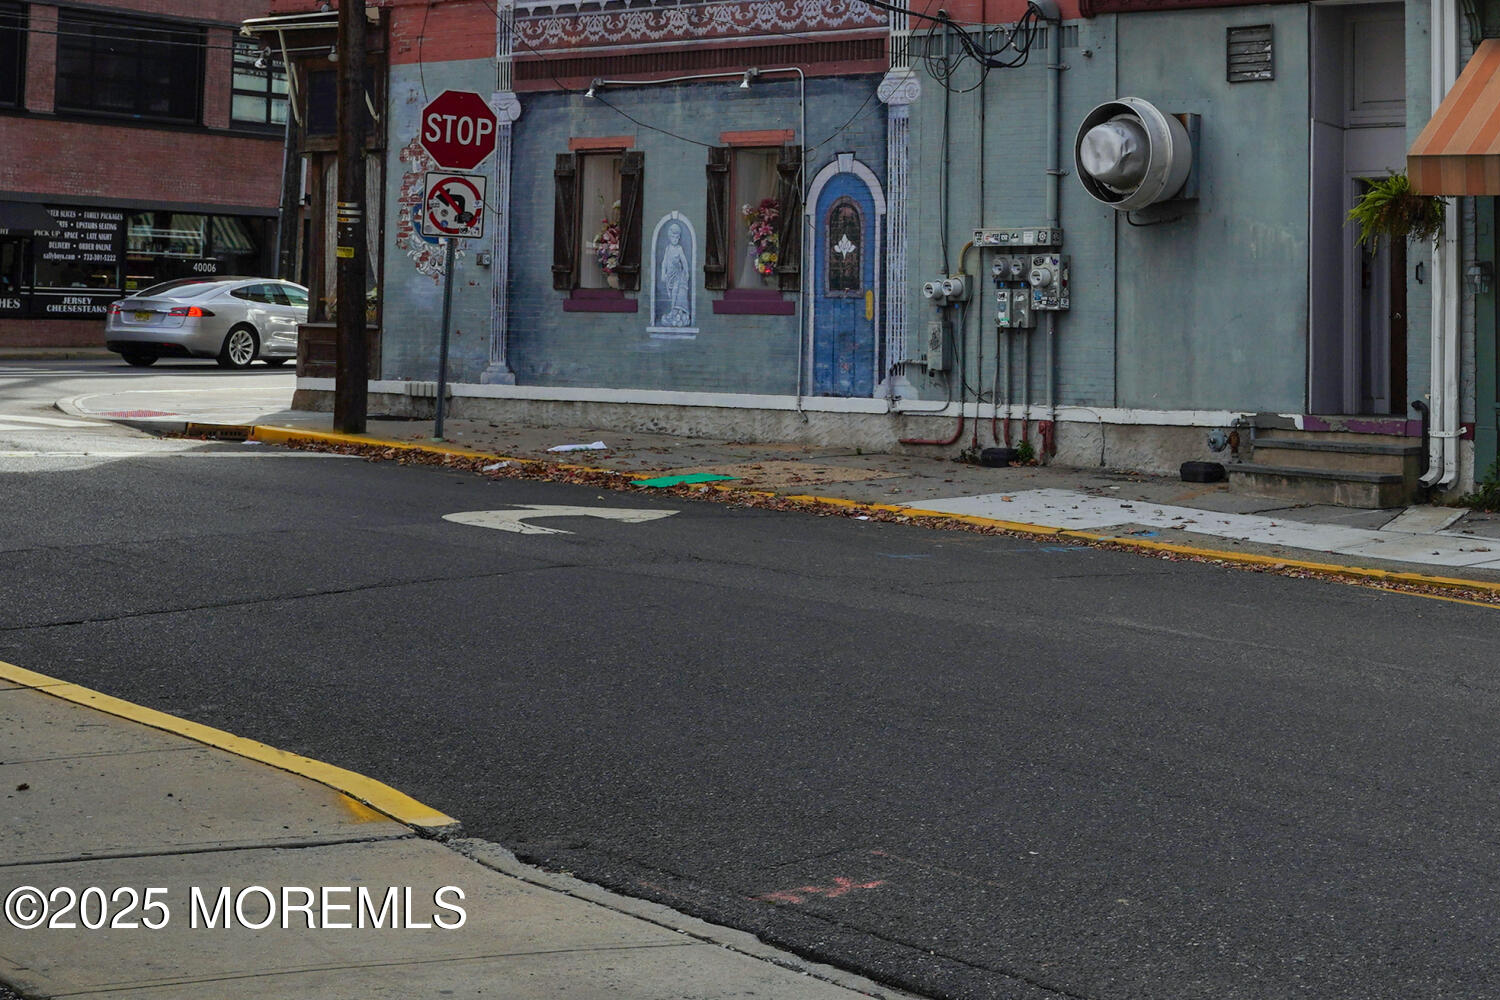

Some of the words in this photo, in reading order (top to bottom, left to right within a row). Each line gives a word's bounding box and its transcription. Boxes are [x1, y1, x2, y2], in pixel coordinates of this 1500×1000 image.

[425, 112, 493, 146] STOP
[84, 210, 99, 219] FAMILY
[100, 211, 123, 220] PACKAGES
[98, 222, 117, 231] SEATING
[86, 232, 97, 240] LATE
[98, 233, 112, 241] NIGHT
[48, 241, 71, 249] DELIVERY
[78, 242, 94, 250] ORDER
[95, 243, 112, 251] ONLINE
[192, 262, 217, 273] 40006
[62, 296, 93, 305] JERSEY
[46, 304, 108, 313] CHEESESTEAKS
